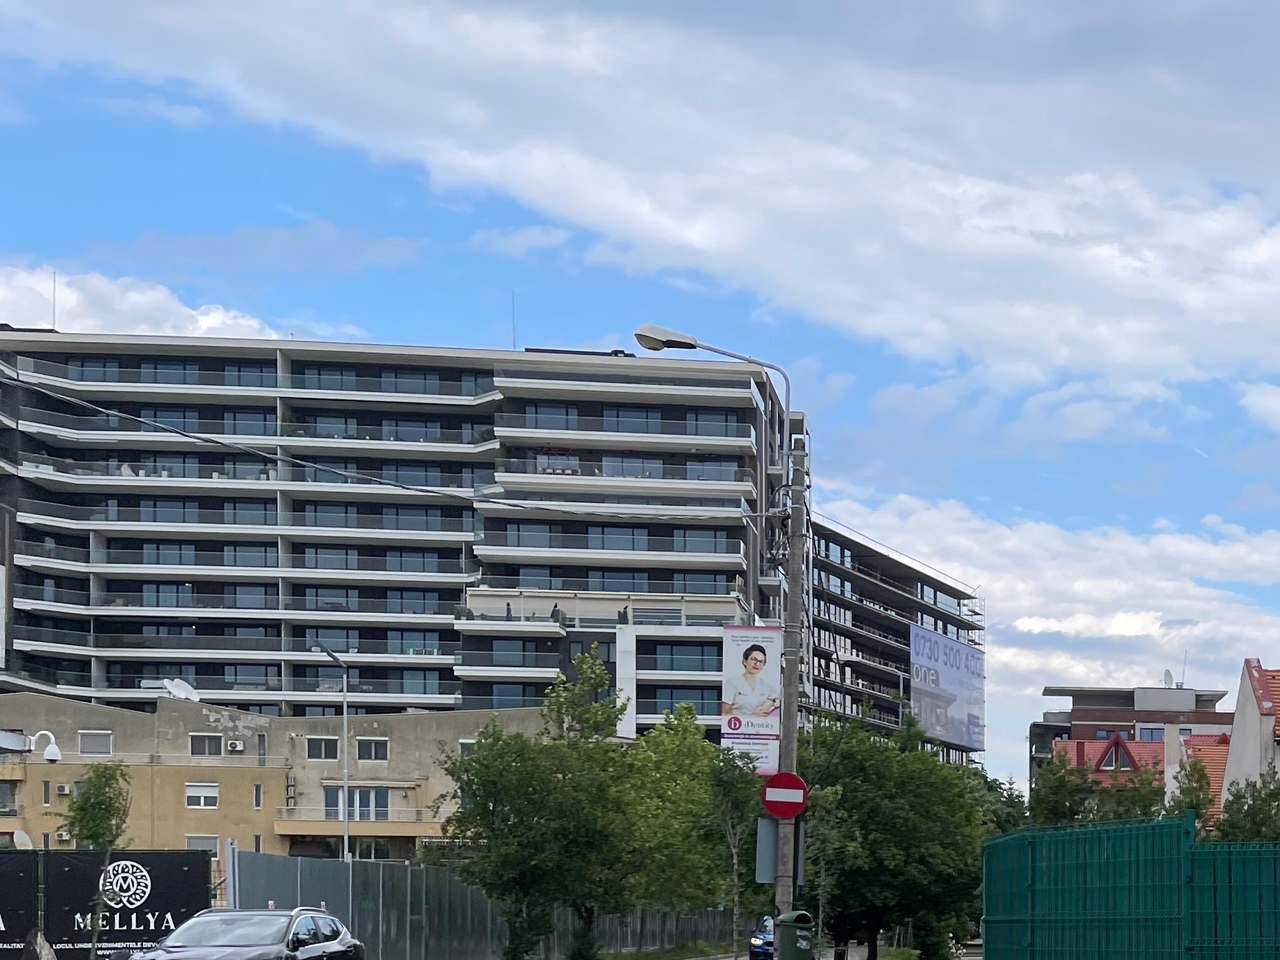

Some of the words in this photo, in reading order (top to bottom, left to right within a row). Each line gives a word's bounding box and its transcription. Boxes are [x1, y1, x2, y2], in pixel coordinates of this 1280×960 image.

[913, 633, 940, 663] 0730
[942, 644, 961, 672] 500
[913, 664, 936, 688] one
[74, 911, 176, 930] MELLYA
